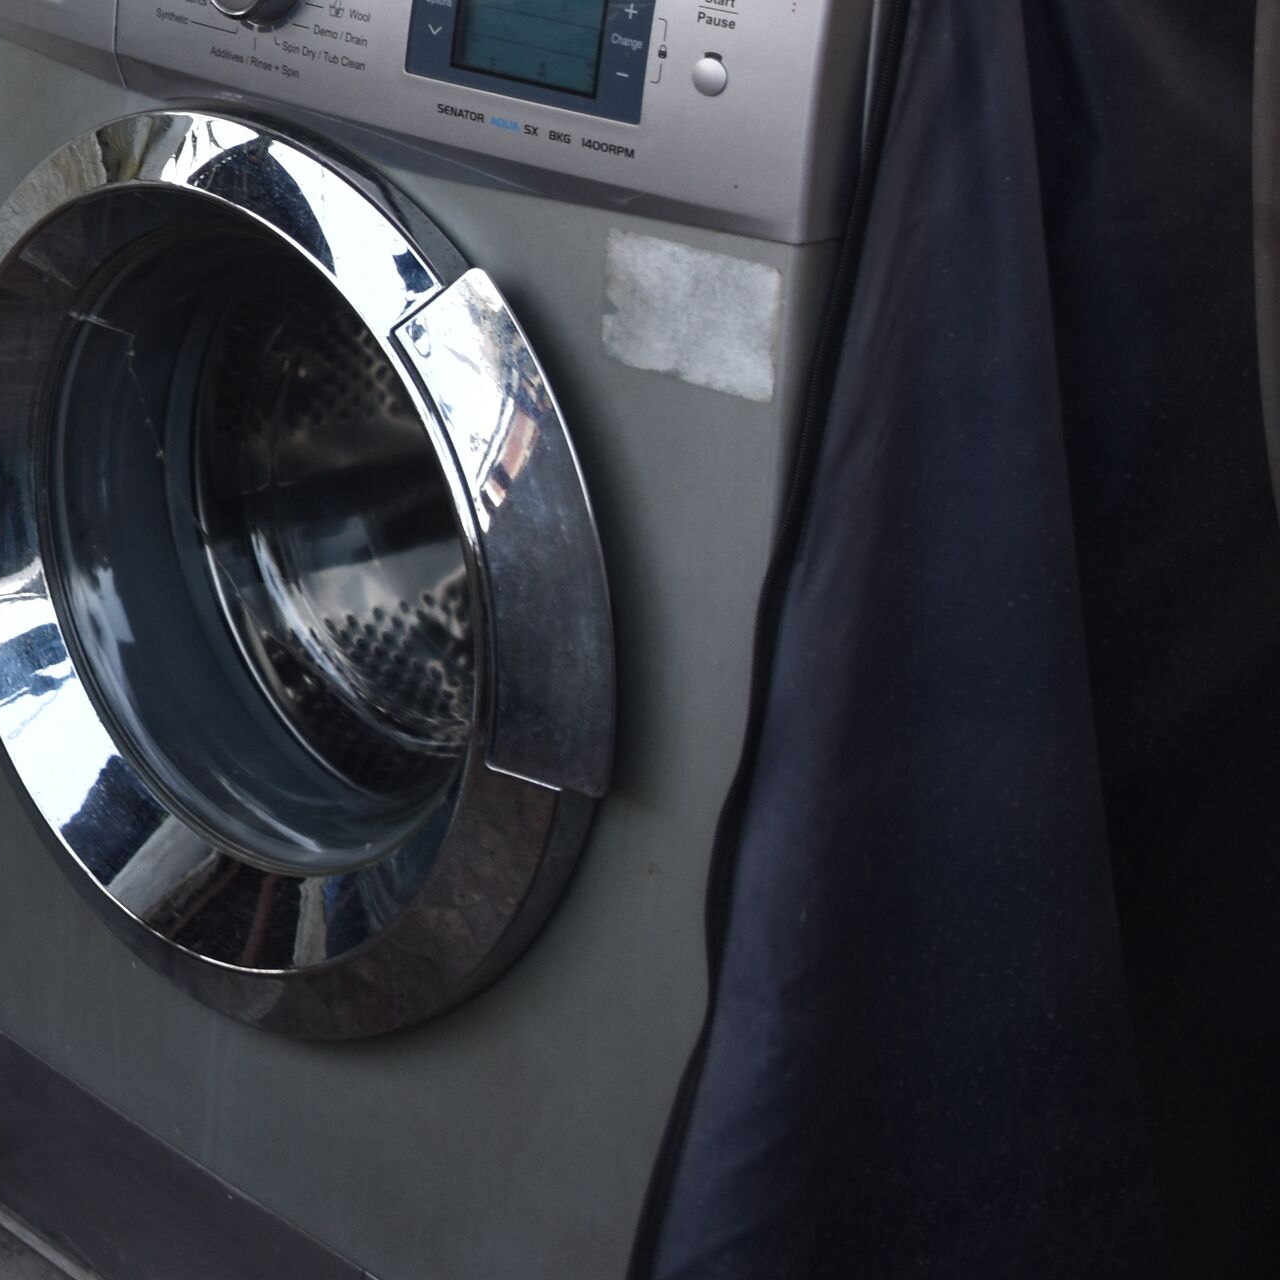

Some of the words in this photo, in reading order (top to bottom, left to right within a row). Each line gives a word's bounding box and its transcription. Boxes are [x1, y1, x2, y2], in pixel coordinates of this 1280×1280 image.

[156, 8, 189, 24] Synthetic
[349, 8, 372, 22] Wool
[697, 12, 736, 30] Pause
[314, 24, 338, 40] Demo
[344, 32, 368, 47] Drain
[611, 32, 644, 51] Change
[210, 46, 244, 64] Additives
[250, 56, 273, 72] Rinse
[282, 64, 300, 78] Spin
[282, 40, 300, 56] Spin
[302, 46, 316, 60] Dry
[324, 52, 340, 65] Tub
[340, 56, 366, 71] Clean
[436, 104, 485, 124] SENATOR
[524, 124, 539, 136] SX
[548, 130, 572, 144] 8KG
[581, 138, 635, 158] 1400RPM
